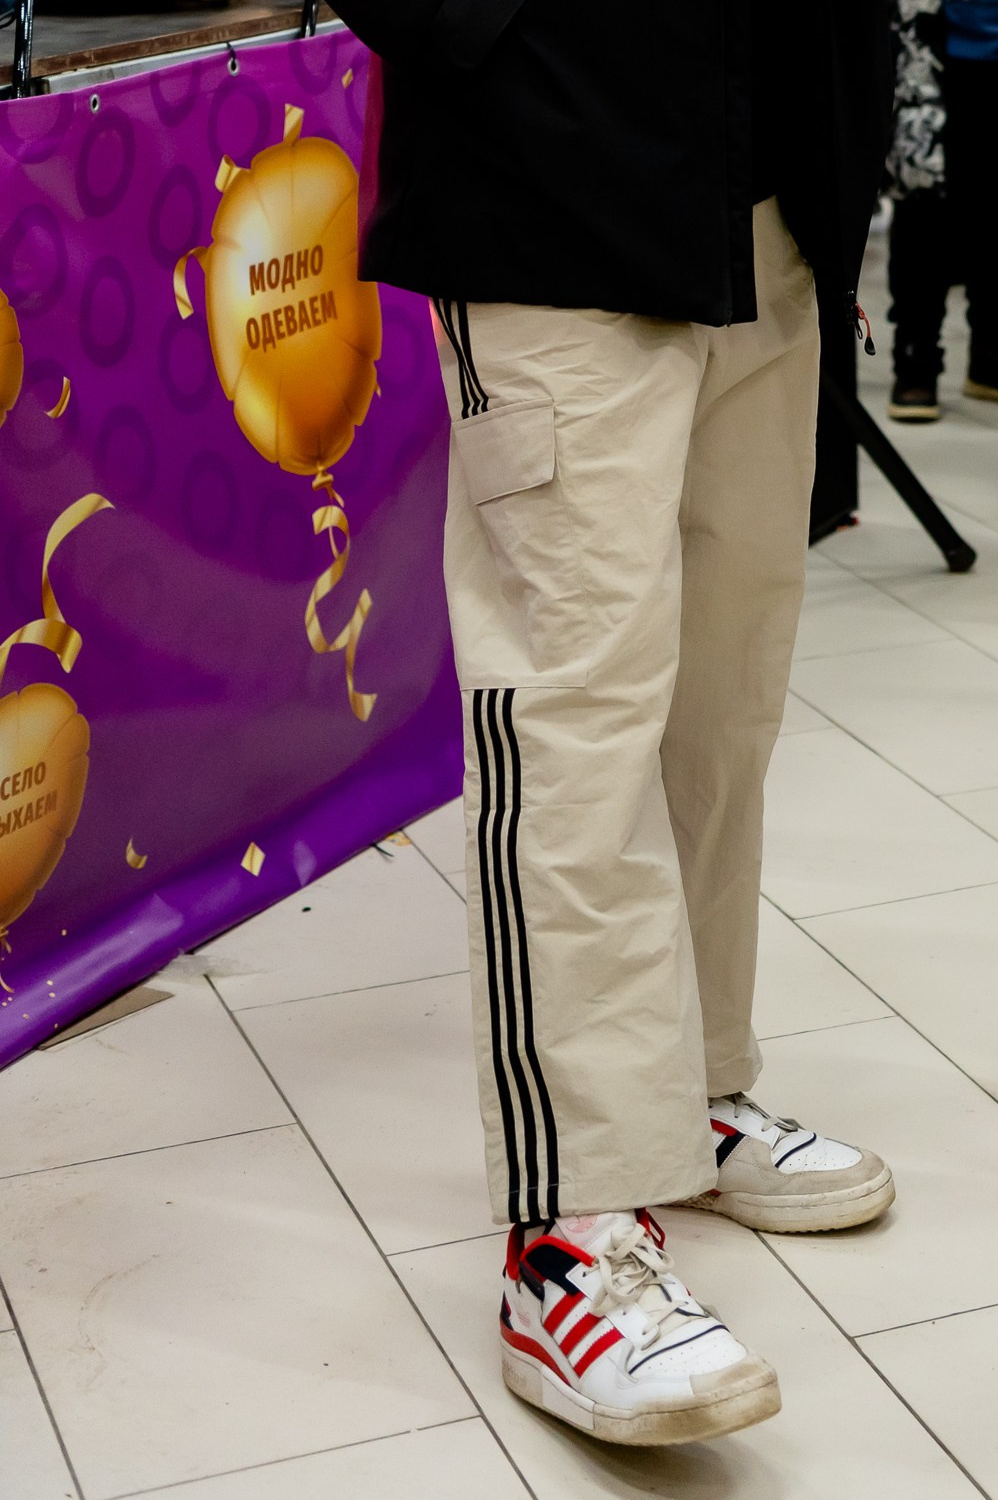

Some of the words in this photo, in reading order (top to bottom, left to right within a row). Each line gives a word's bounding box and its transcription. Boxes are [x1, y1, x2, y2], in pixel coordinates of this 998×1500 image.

[249, 244, 324, 296] МОДНО
[246, 291, 338, 353] ОДЕВАЕМ
[0, 761, 47, 801] СЕЛО
[0, 788, 58, 838] ЫХАЕМ
